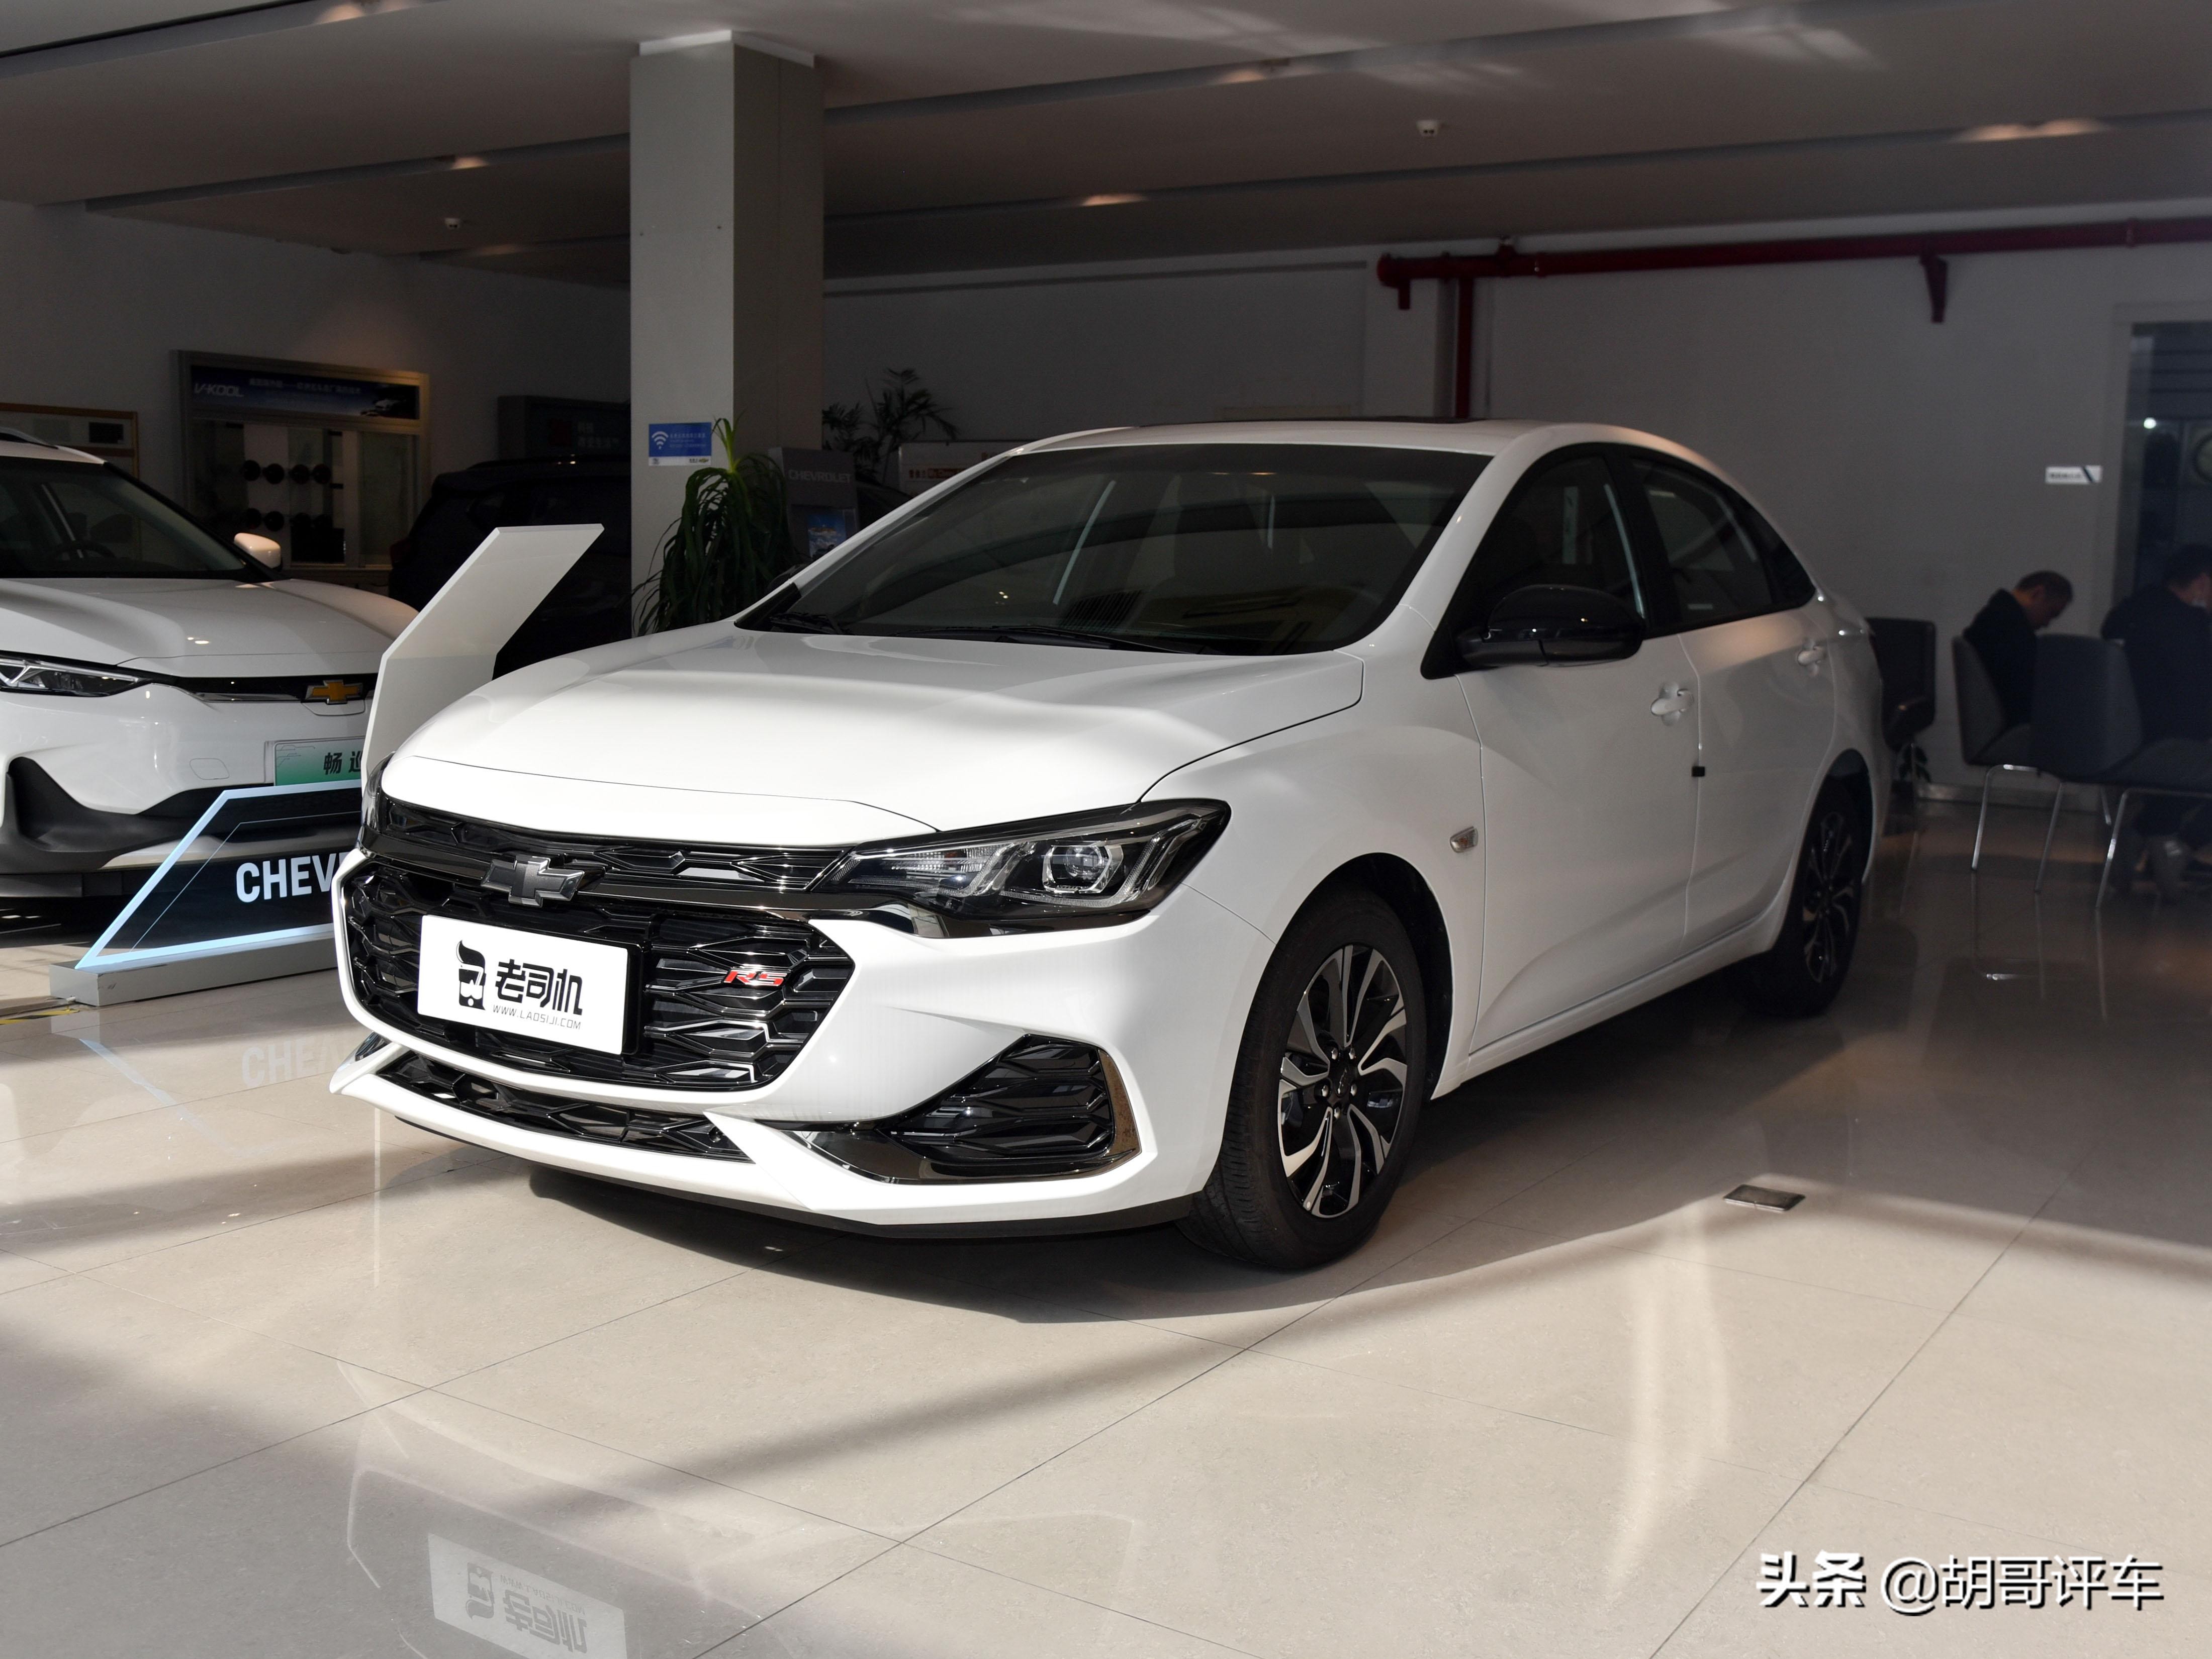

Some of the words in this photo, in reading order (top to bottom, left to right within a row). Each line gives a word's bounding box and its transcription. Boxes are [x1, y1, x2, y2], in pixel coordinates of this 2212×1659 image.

[194, 383, 244, 397] V-KOOL
[788, 469, 852, 483] CHEVROLET
[236, 852, 353, 903] CHEV
[495, 959, 583, 1016] 老司机
[723, 969, 788, 986] RS
[493, 1004, 581, 1030] WWW.LAOSIJI.COM
